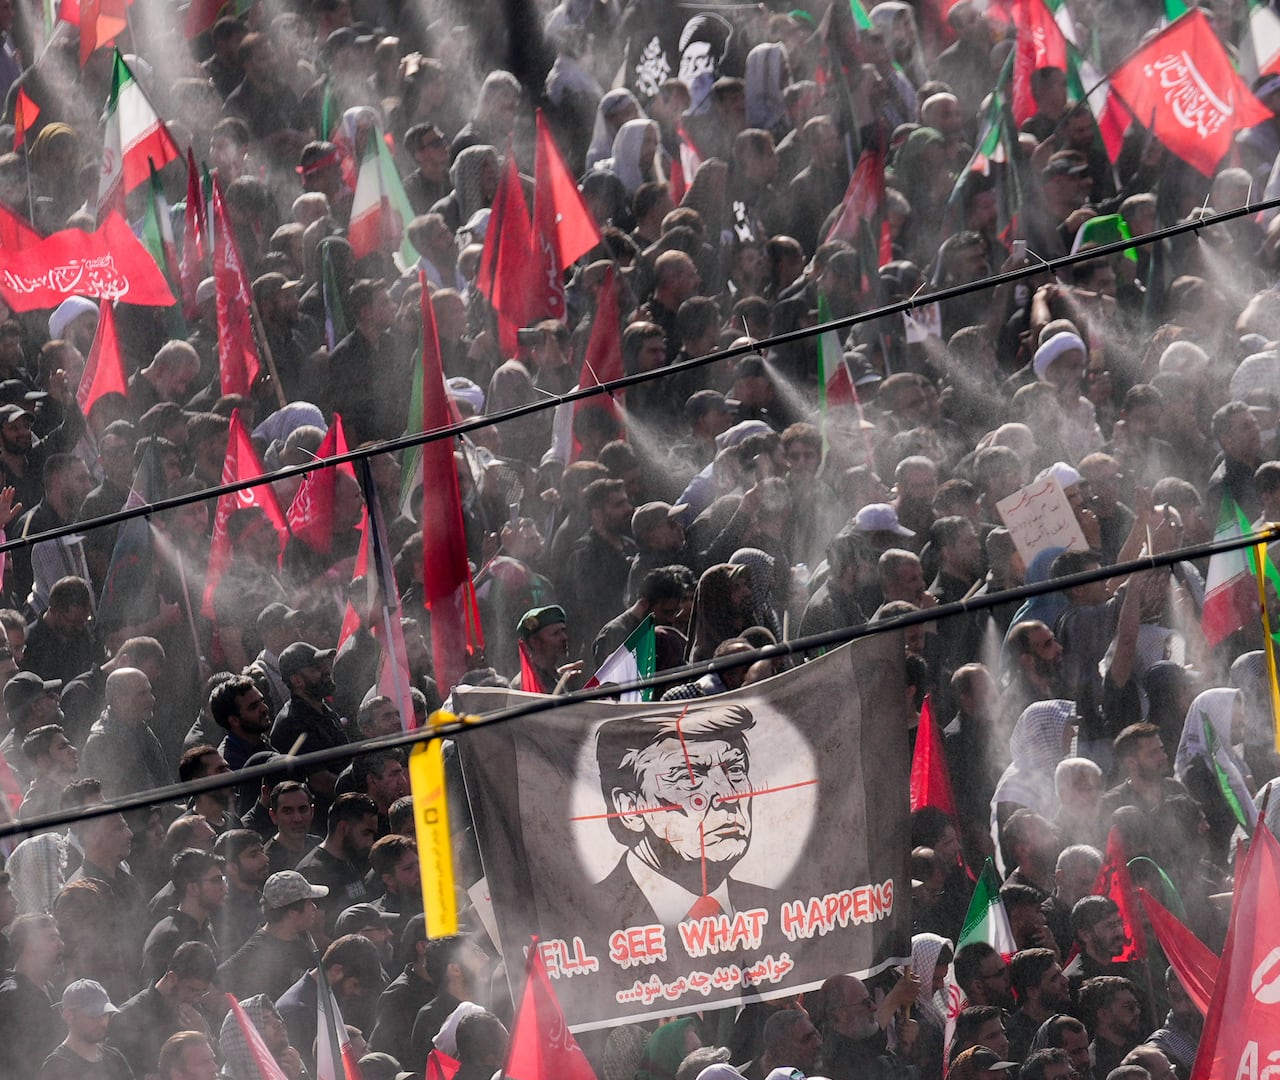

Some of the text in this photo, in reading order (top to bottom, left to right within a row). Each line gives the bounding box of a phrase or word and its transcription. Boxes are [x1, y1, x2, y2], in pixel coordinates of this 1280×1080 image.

[523, 879, 894, 979] E'LL SEE WHAT HAPPENS
[689, 971, 711, 995] چه
[713, 965, 741, 990] دید
[742, 953, 794, 988] خواهیم
[664, 977, 687, 1000] می
